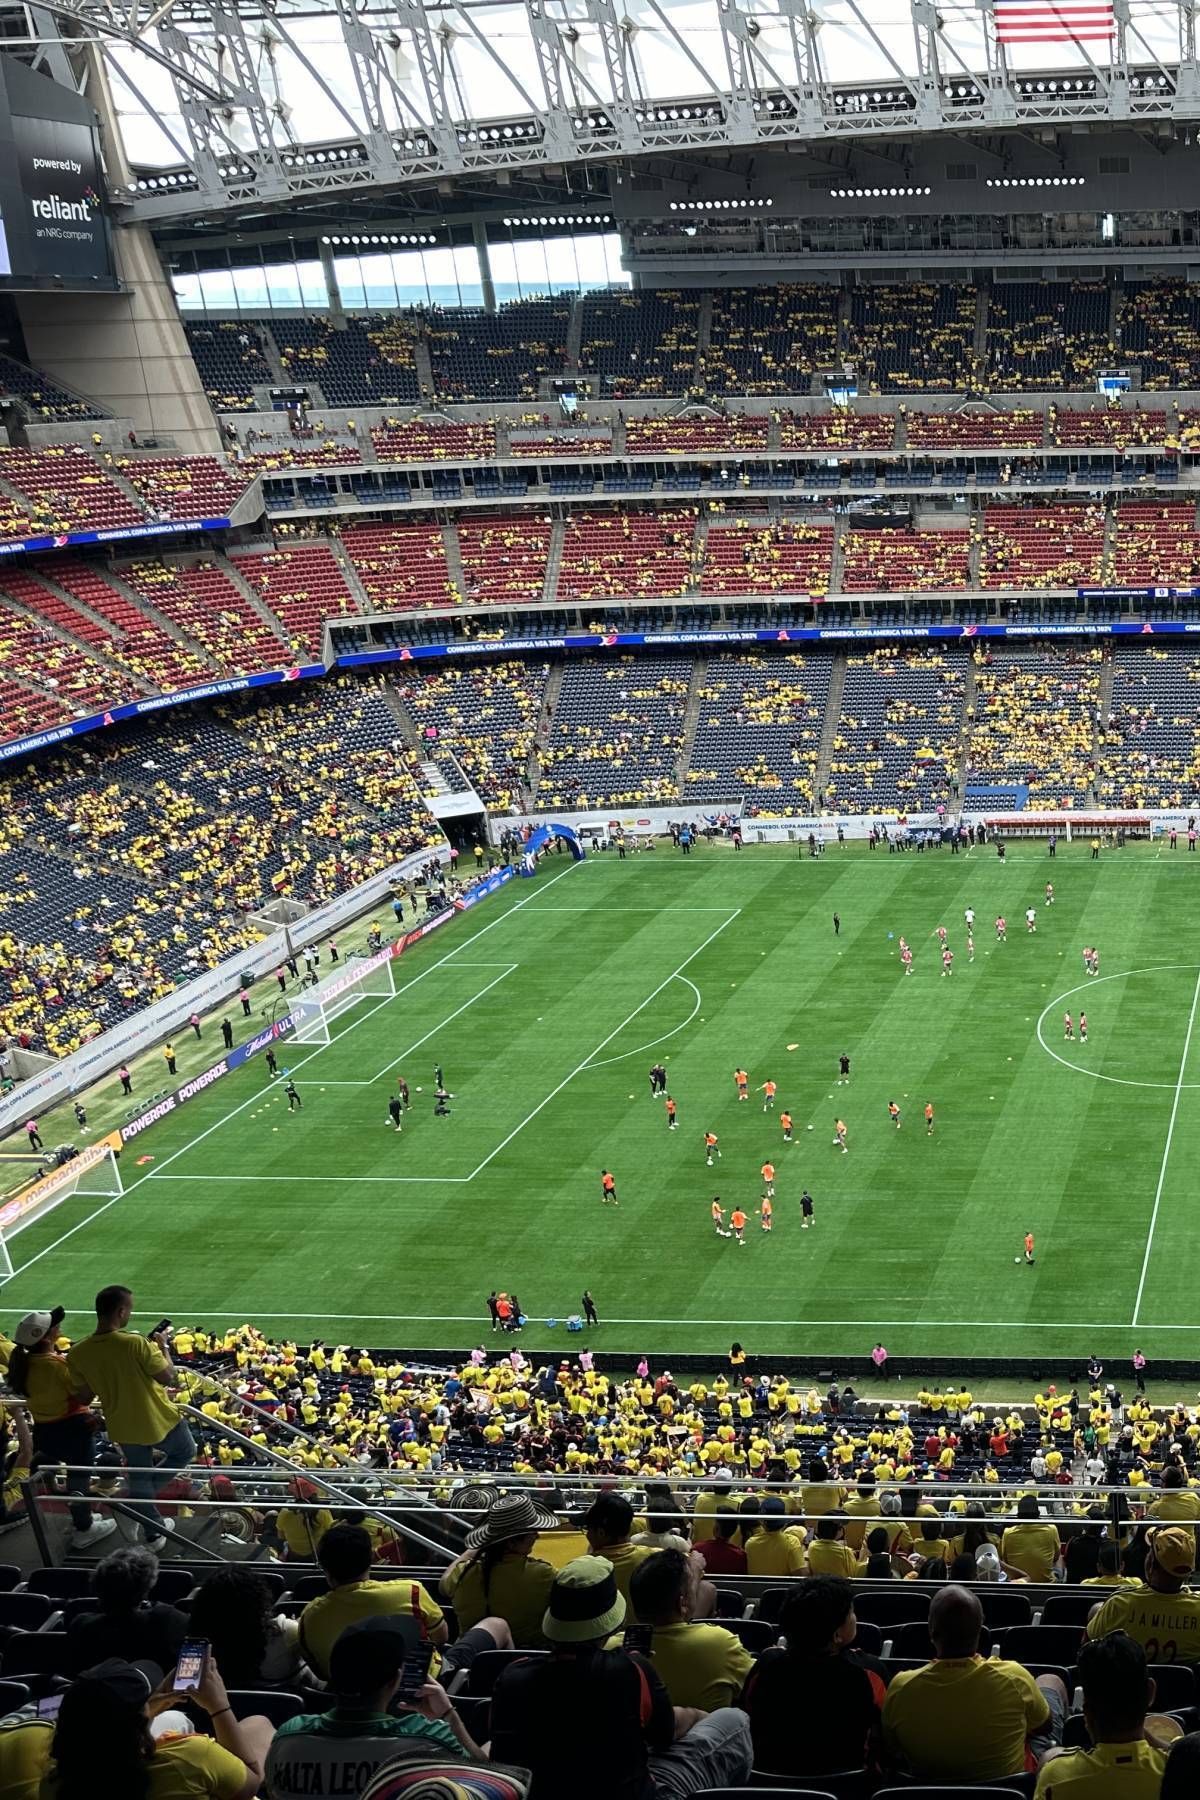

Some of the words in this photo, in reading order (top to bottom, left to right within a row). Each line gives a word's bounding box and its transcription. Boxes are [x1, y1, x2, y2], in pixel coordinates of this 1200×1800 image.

[33, 158, 70, 170] powered
[71, 160, 81, 174] by
[32, 194, 92, 221] reliant
[37, 229, 45, 237] an
[46, 228, 62, 238] NRG
[63, 230, 93, 242] company
[447, 644, 485, 653] CONMEBOL
[504, 642, 534, 650] AMERICA
[138, 699, 170, 712] CONMEBOL
[172, 694, 189, 704] COPA
[189, 687, 217, 701] AMERICA
[219, 684, 231, 693] USA
[232, 681, 249, 690] 2024
[5, 746, 22, 757] COPA
[22, 737, 47, 753] AMERICA
[48, 732, 59, 744] USA
[59, 727, 73, 737] 2024
[279, 1008, 307, 1032] ULTRA
[179, 1060, 228, 1101] POWERADE
[122, 1097, 177, 1141] POWERADE
[25, 1158, 83, 1205] mercado
[1129, 1610, 1135, 1623] J
[1140, 1612, 1146, 1626] A
[1152, 1614, 1197, 1630] MILLER
